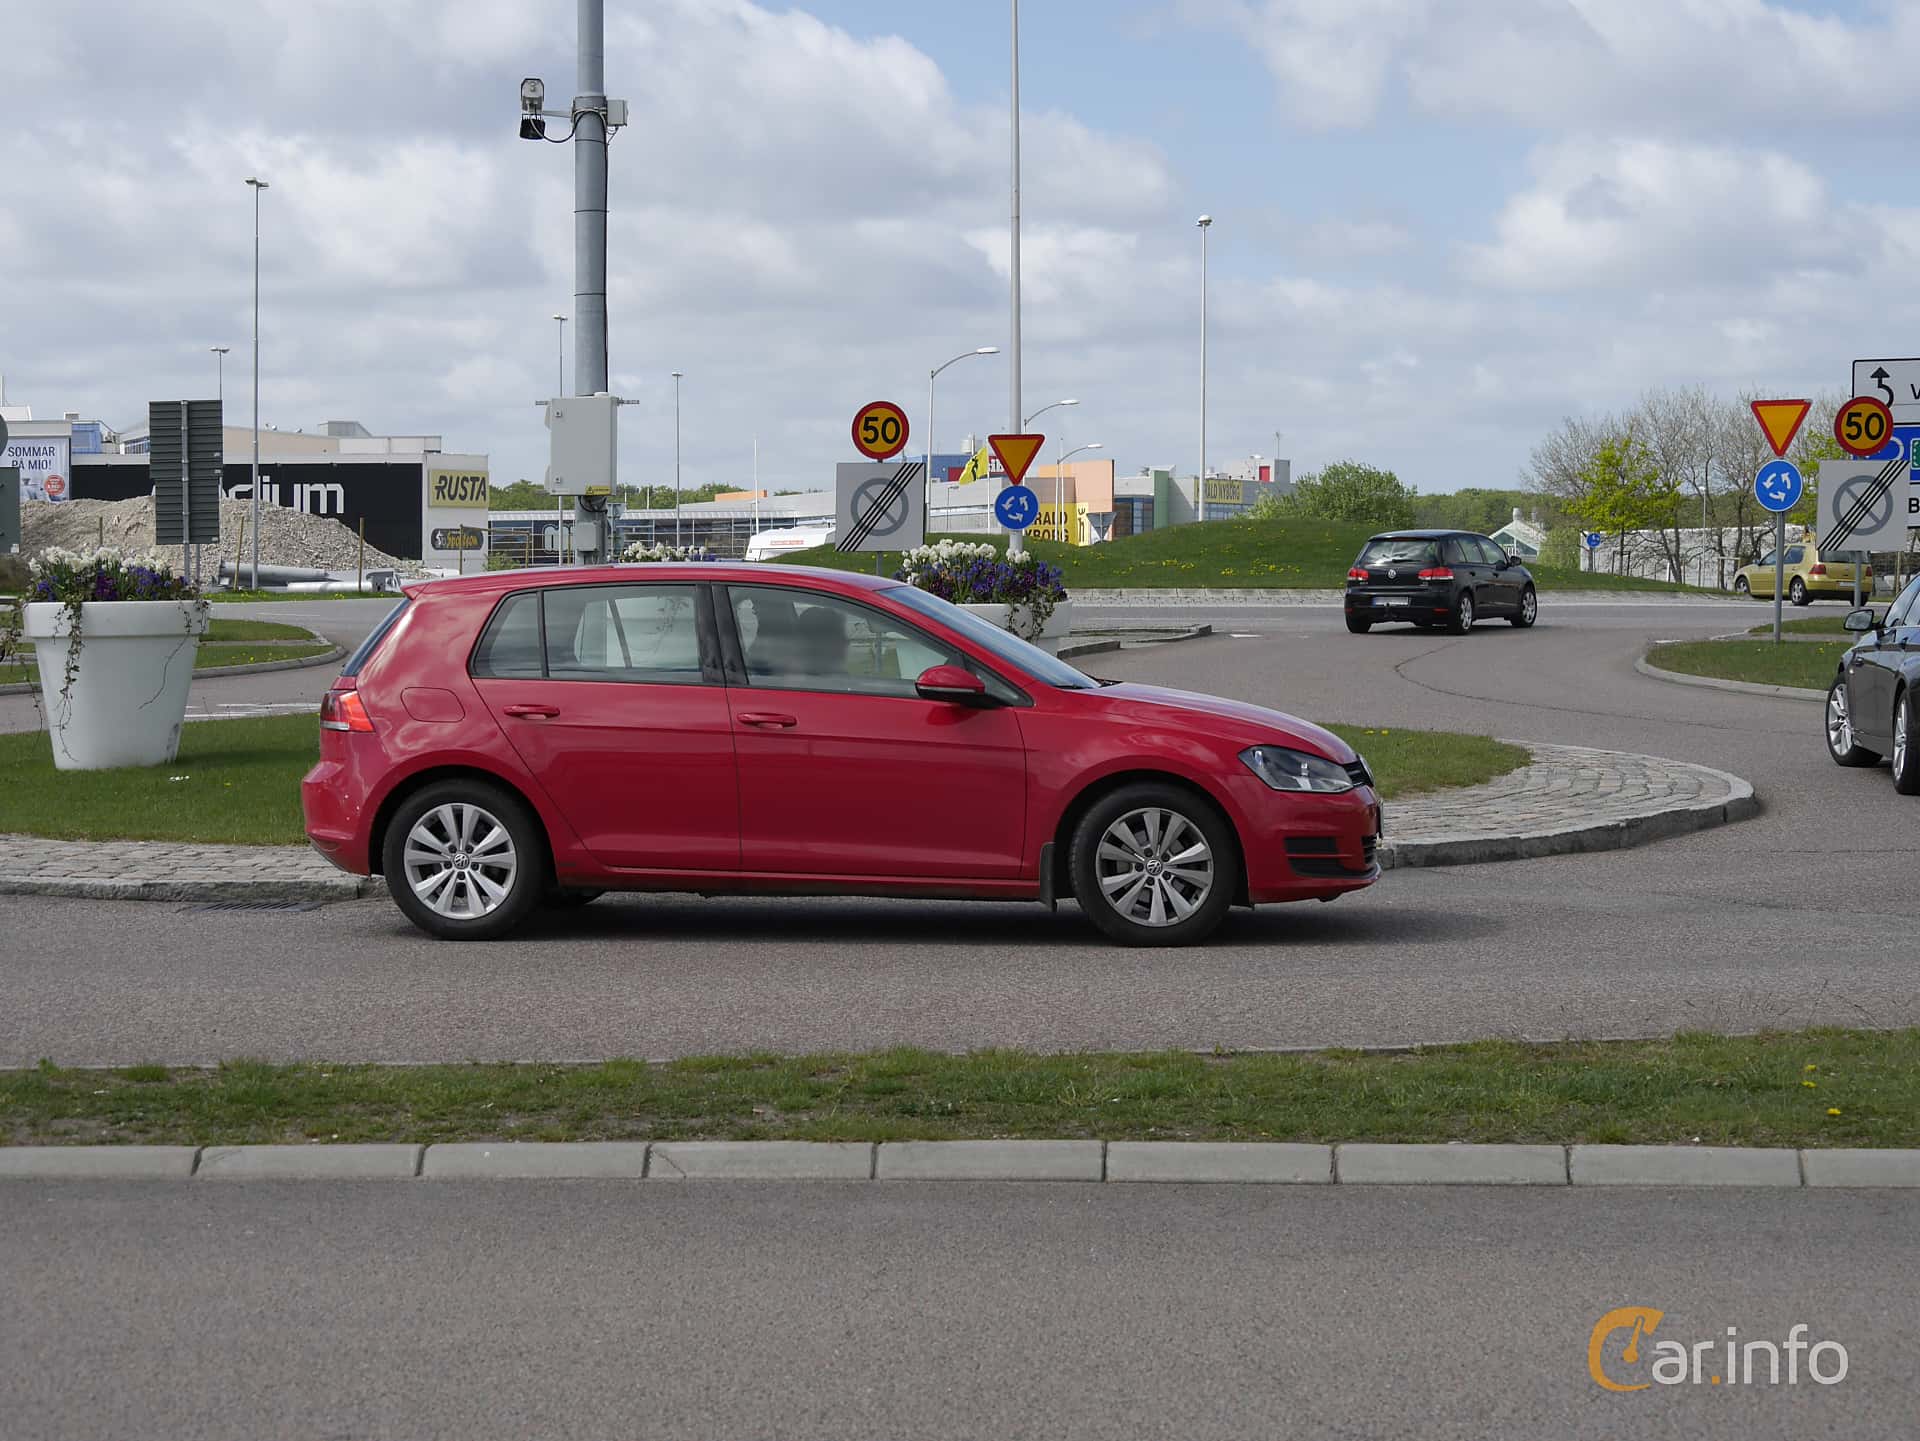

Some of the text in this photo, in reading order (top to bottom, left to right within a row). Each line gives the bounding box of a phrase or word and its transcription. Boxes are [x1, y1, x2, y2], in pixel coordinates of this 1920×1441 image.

[863, 416, 901, 444] 50
[1845, 412, 1885, 441] 50
[8, 446, 56, 457] SOMMAR
[28, 459, 52, 471] MIO!
[434, 475, 487, 502] RUSTA
[1034, 511, 1068, 525] RALD
[1024, 529, 1070, 542] YBORG
